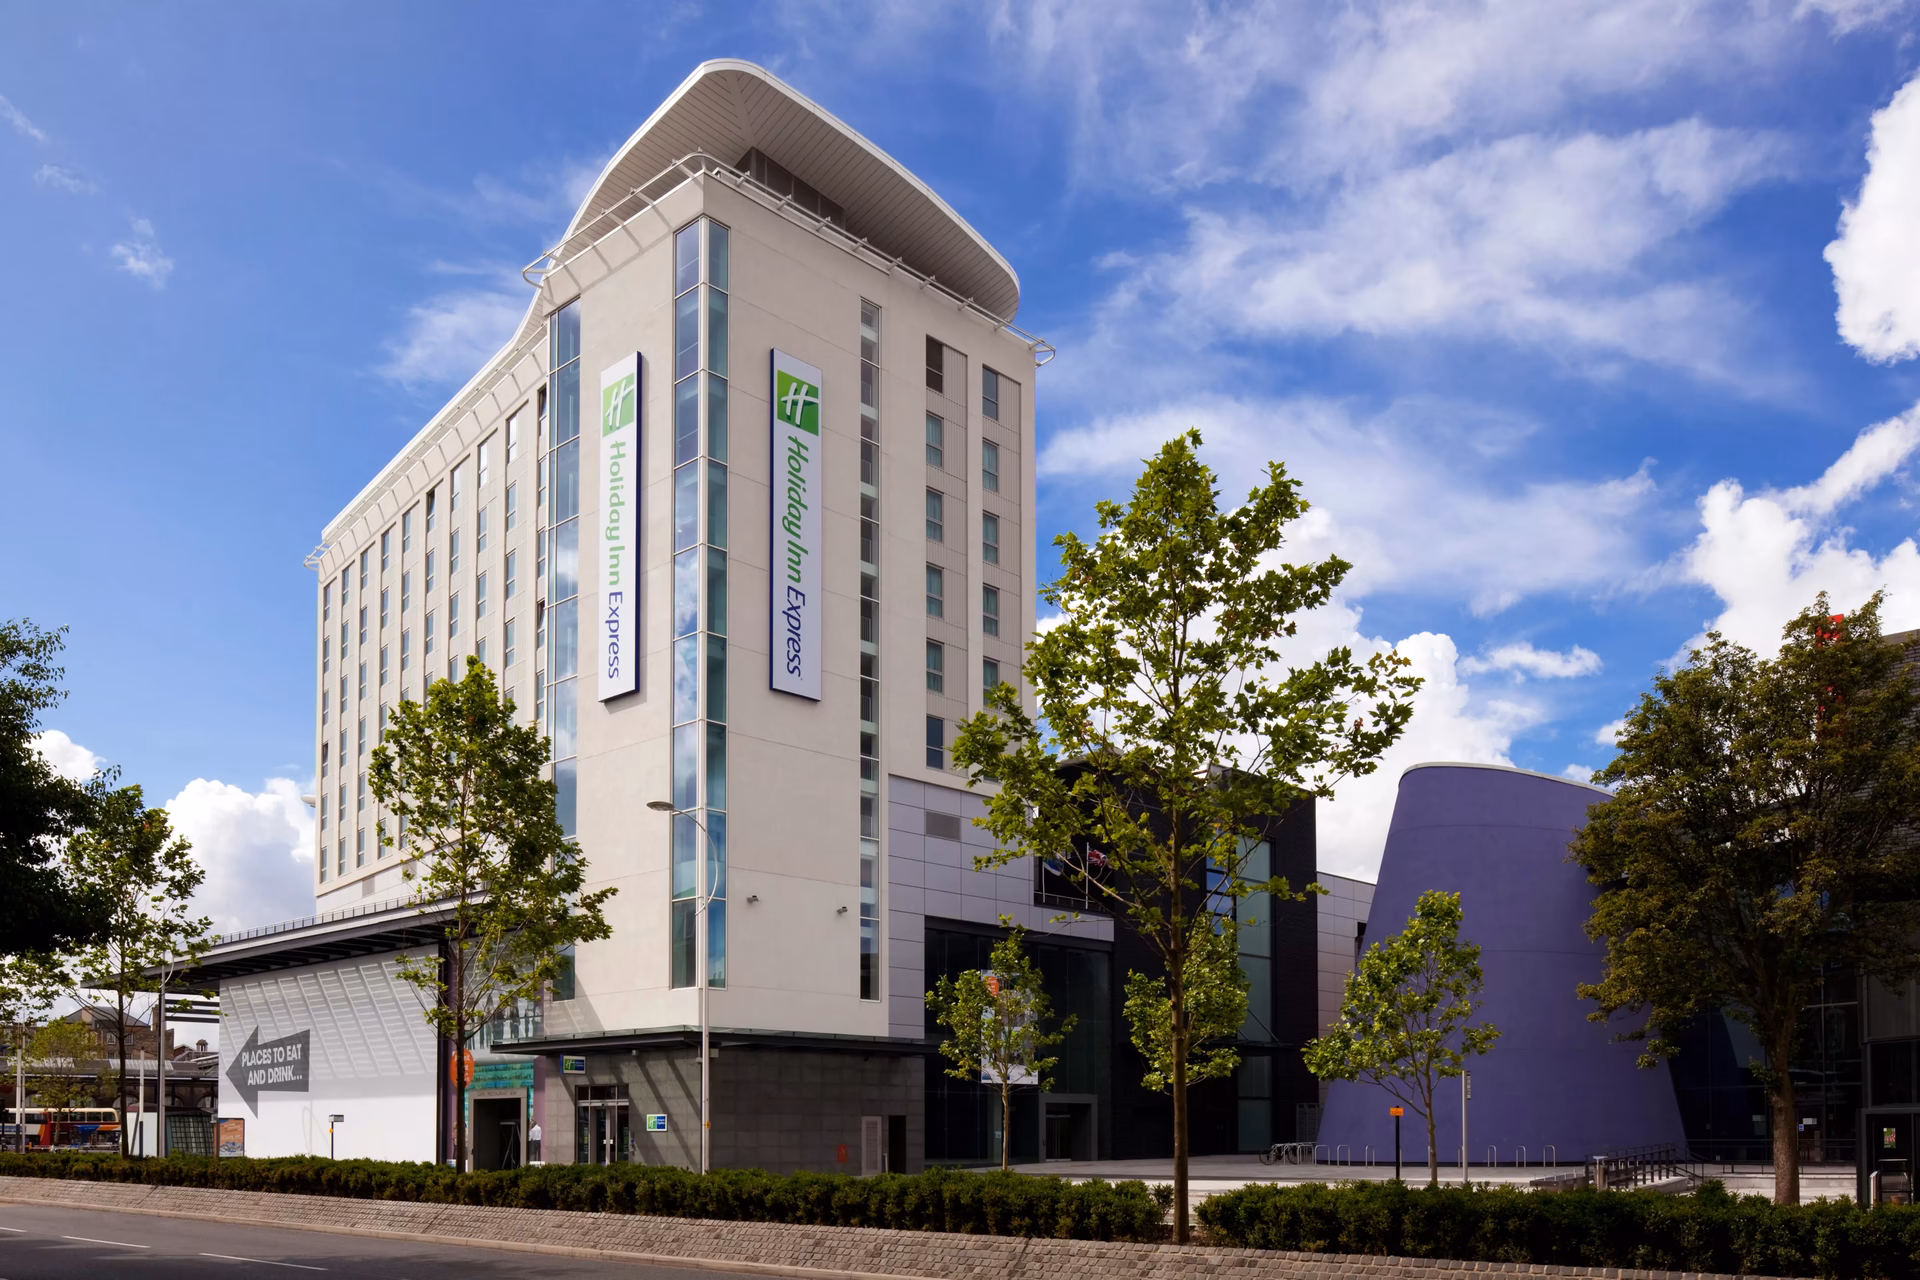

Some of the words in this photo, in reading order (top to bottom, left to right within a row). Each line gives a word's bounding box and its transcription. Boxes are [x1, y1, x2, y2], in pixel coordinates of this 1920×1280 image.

[605, 440, 627, 540] Holiday
[782, 435, 809, 540] Holiday
[608, 545, 626, 586] Inn
[787, 539, 809, 584] Inn
[605, 591, 623, 679] Express
[782, 585, 806, 678] Express
[241, 1048, 272, 1068] PLACES
[273, 1046, 285, 1063] TO
[286, 1043, 302, 1061] EAT
[247, 1069, 266, 1086] AND
